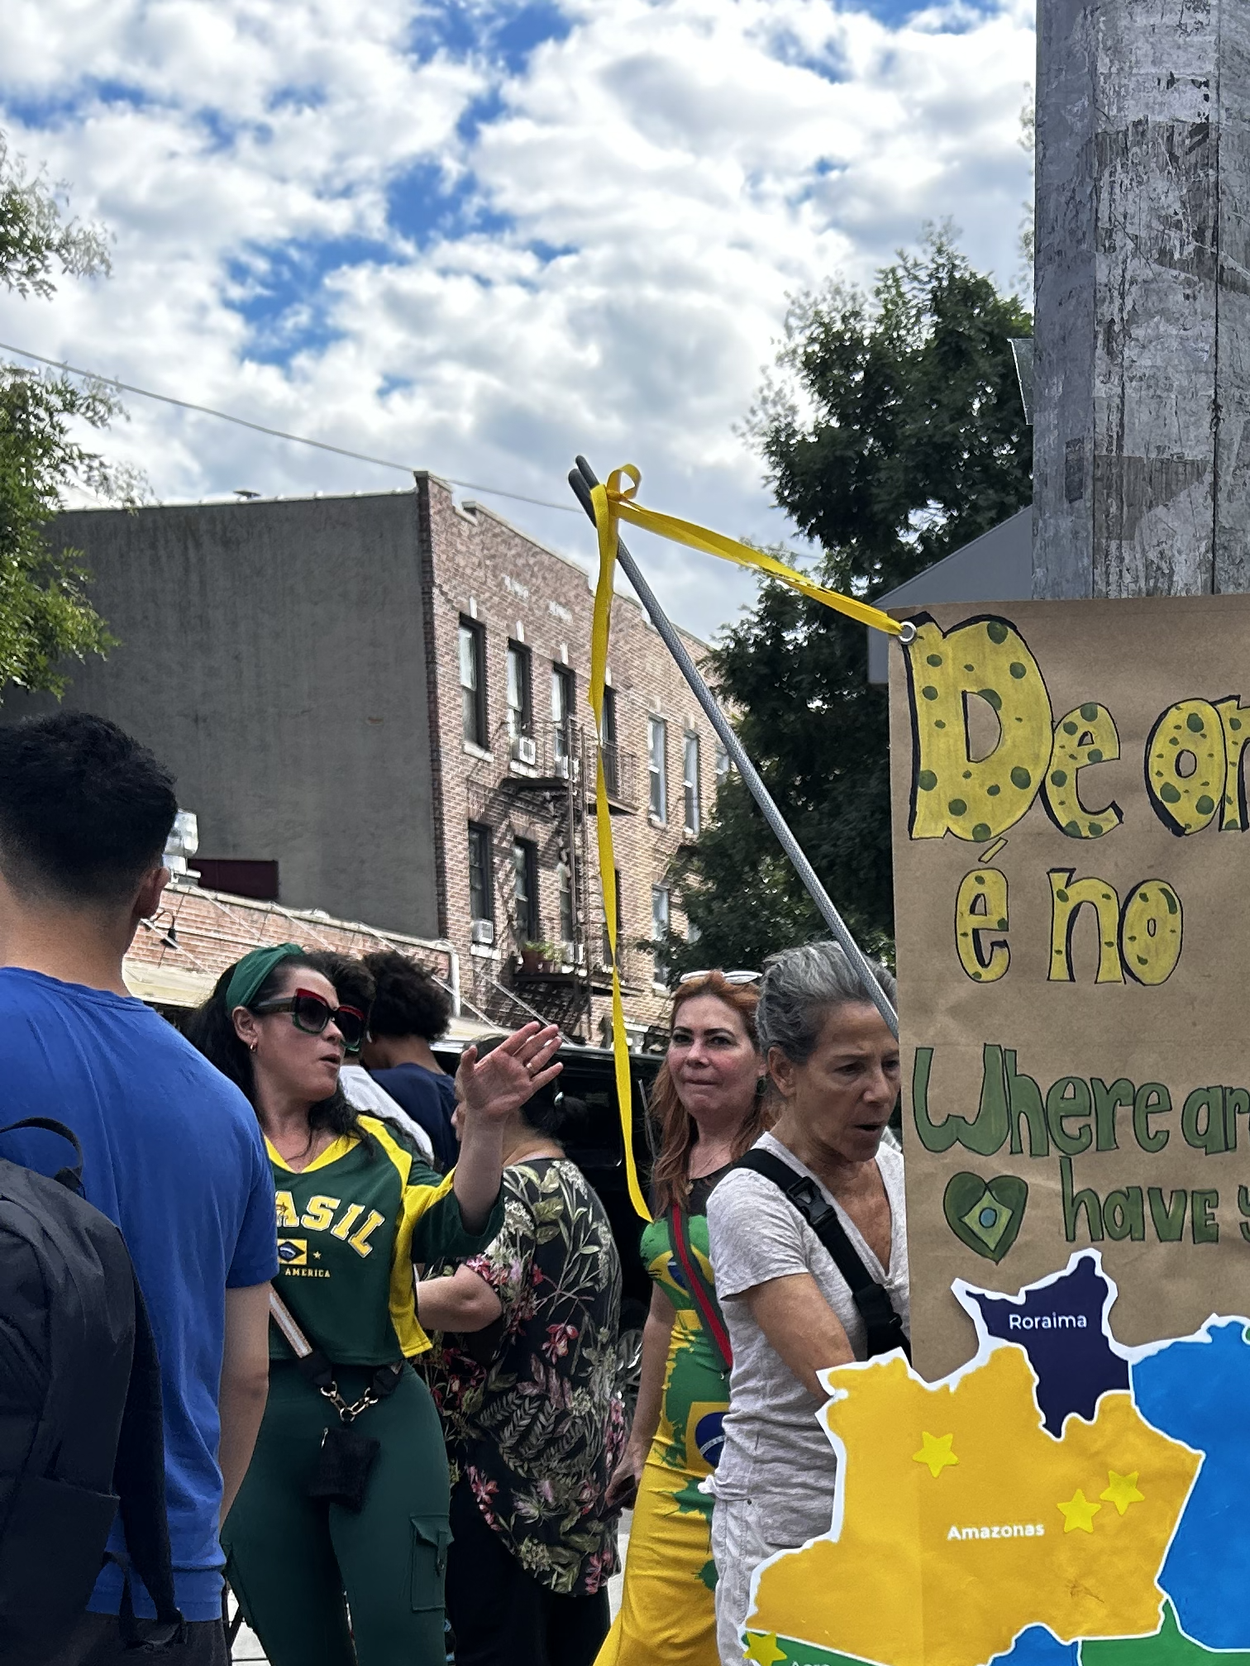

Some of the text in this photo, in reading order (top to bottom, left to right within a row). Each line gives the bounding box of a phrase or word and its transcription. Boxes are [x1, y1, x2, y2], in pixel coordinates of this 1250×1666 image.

[905, 612, 1123, 841] De
[954, 838, 1010, 984] é
[1046, 867, 1183, 986] no
[912, 1043, 1172, 1157] Where
[275, 1190, 386, 1258] ASIL
[285, 1267, 331, 1278] AMERICA
[1008, 1311, 1089, 1331] Roraima
[946, 1520, 1045, 1542] Amazonas
